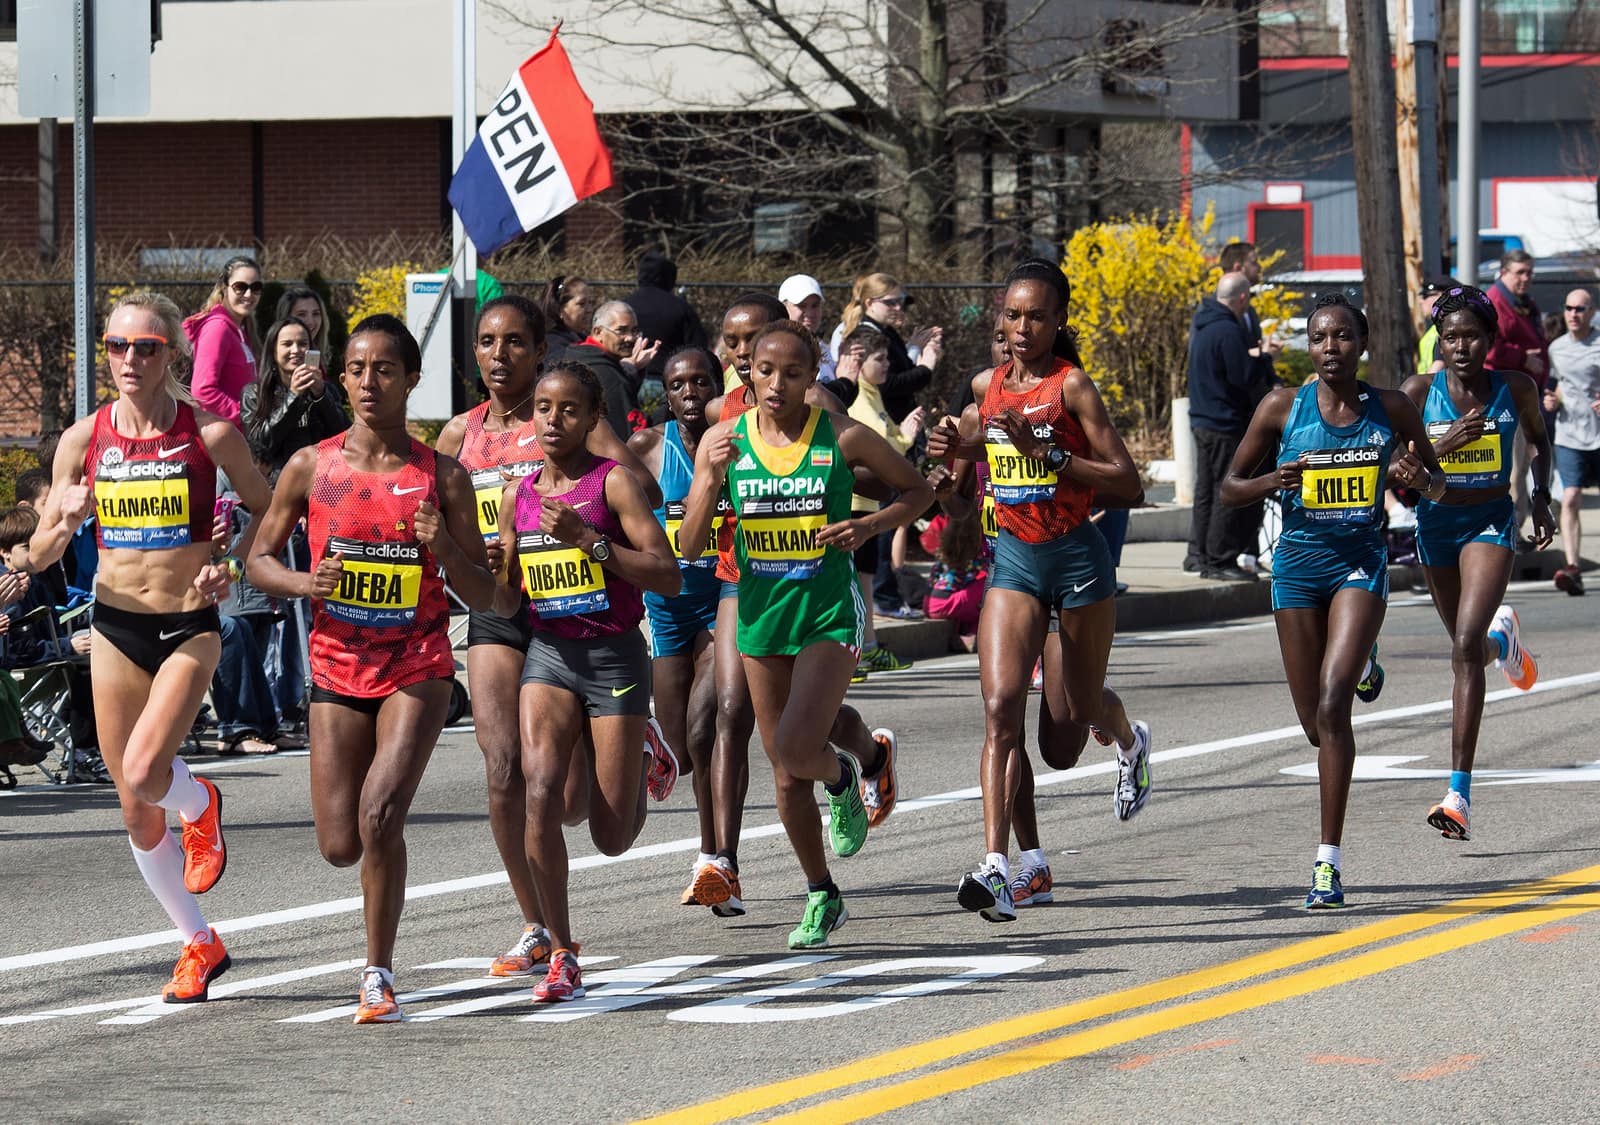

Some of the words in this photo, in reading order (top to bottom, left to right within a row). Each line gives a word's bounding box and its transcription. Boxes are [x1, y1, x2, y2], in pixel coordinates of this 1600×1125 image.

[490, 88, 556, 194] PEN
[414, 283, 443, 294] Phon
[1333, 449, 1380, 463] adidas
[131, 462, 183, 477] adidas
[736, 476, 826, 497] ETHIOPIA
[1316, 476, 1369, 505] KILEL
[101, 495, 183, 518] FLANAGAN
[774, 497, 824, 513] adidas
[365, 544, 419, 559] adidas
[527, 558, 595, 592] DIBABA
[340, 570, 402, 604] DEBA
[348, 606, 369, 615] BOSTON
